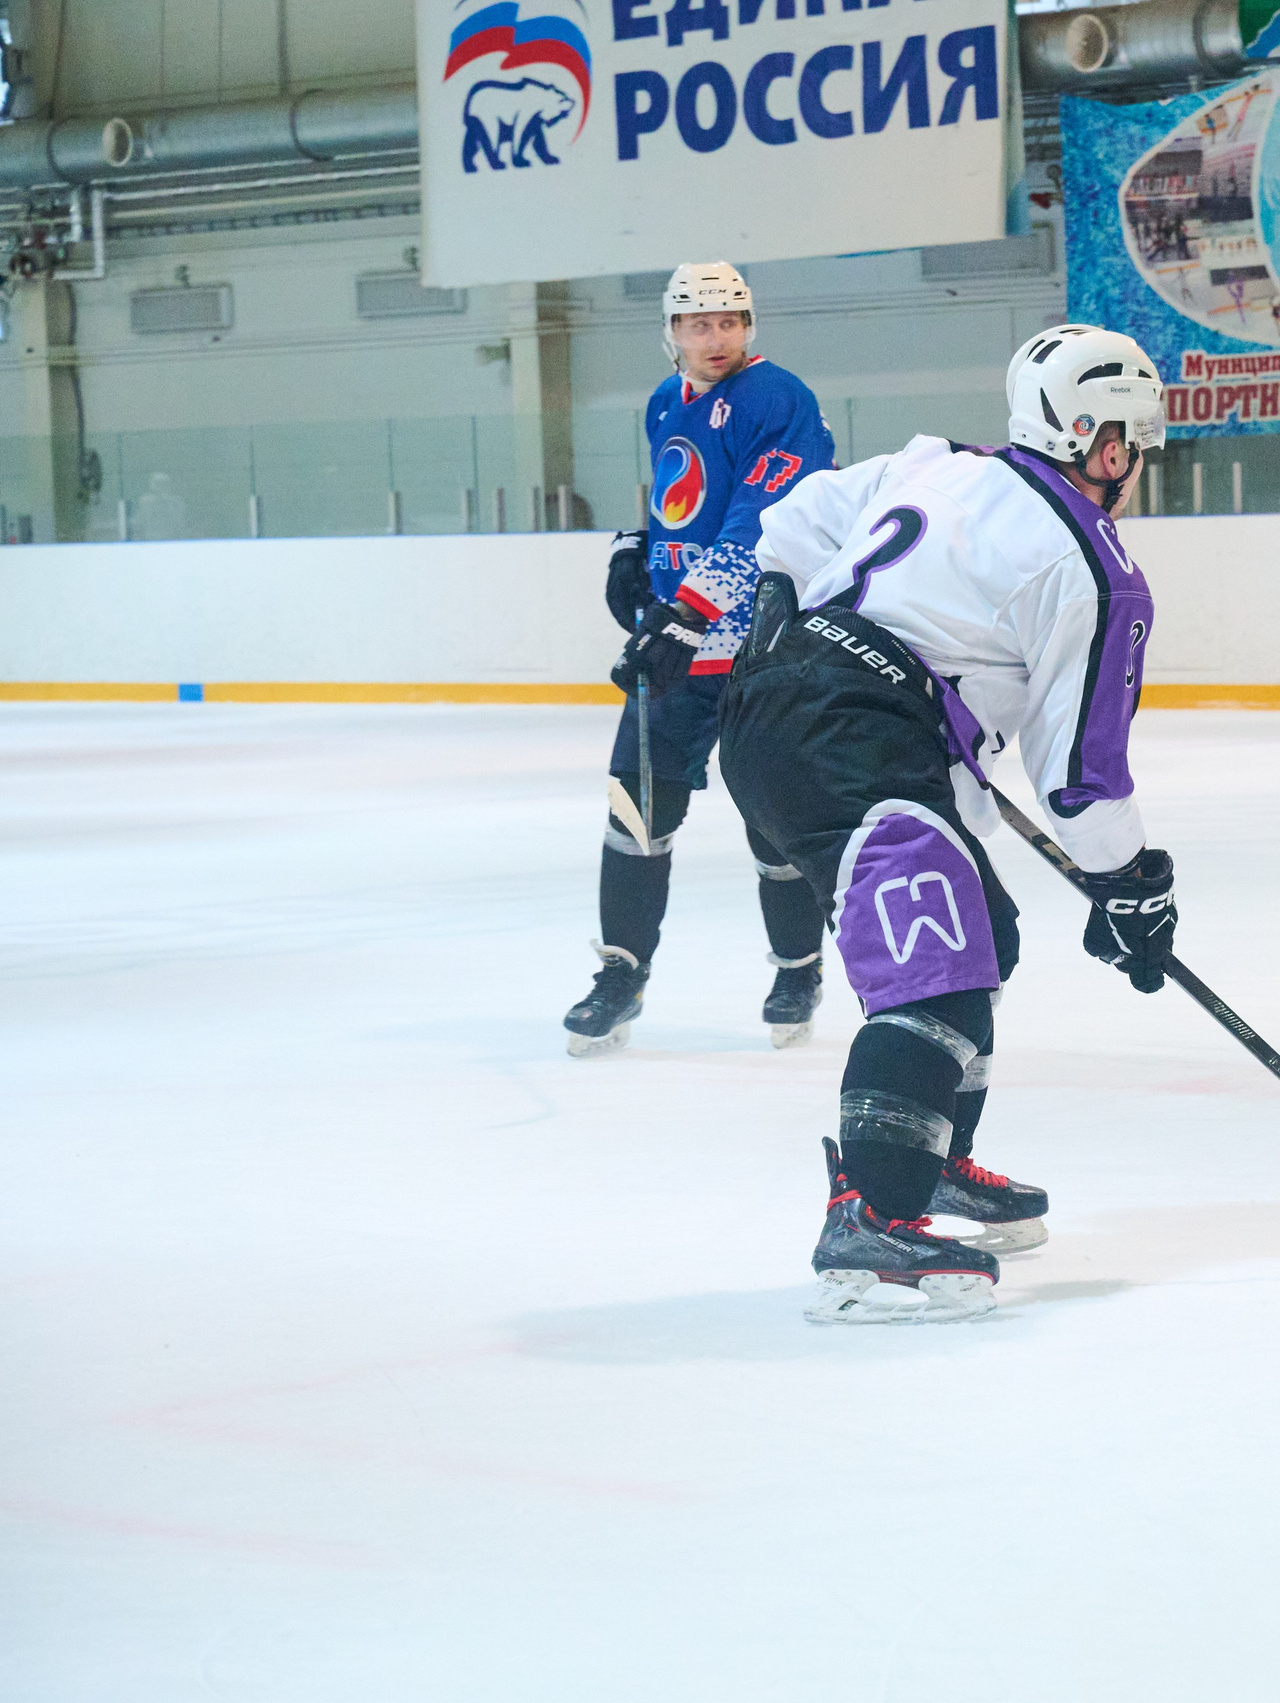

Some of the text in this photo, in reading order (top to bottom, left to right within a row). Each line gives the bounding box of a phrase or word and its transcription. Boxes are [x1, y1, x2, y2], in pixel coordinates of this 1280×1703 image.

[613, 24, 1000, 162] РОССИЯ
[698, 288, 728, 296] CCM
[1110, 386, 1132, 394] Reebok
[803, 615, 907, 685] BAUER
